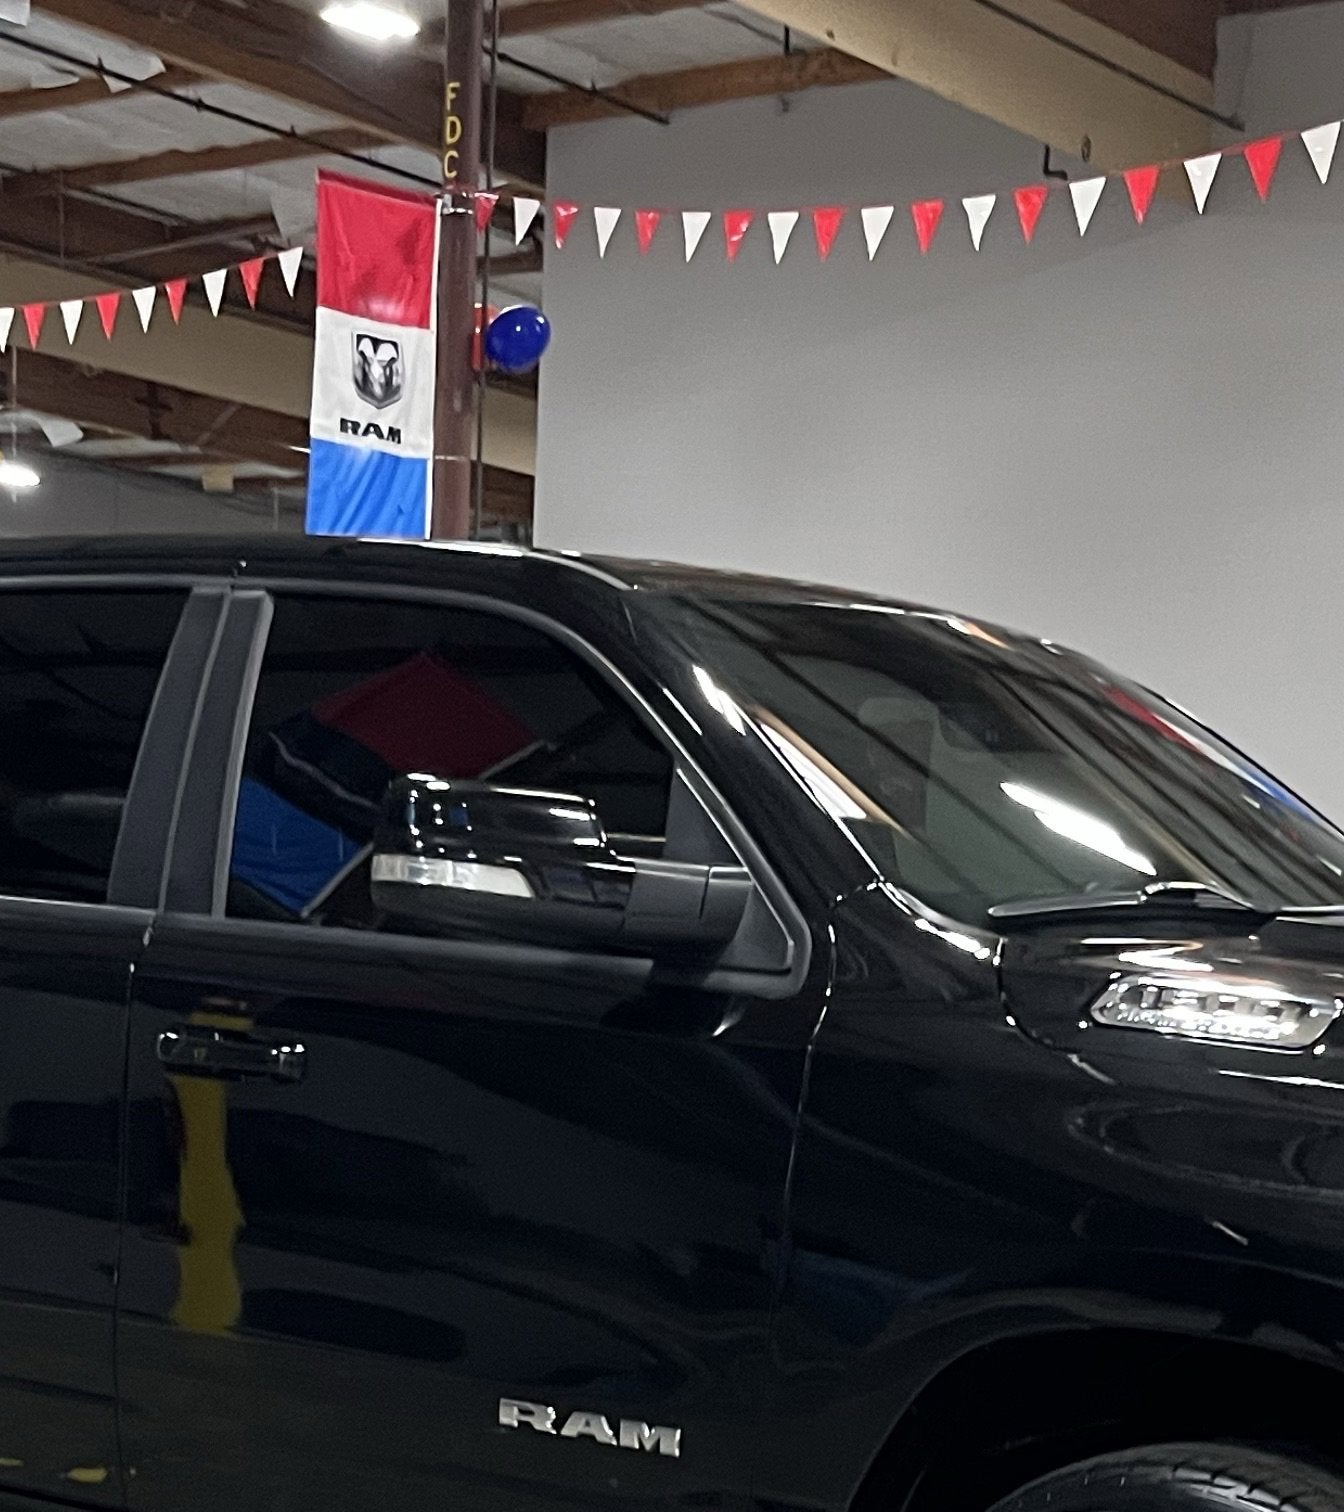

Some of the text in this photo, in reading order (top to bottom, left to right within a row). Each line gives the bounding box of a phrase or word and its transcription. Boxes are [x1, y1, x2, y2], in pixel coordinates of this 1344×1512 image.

[444, 82, 462, 178] FDC
[339, 417, 401, 444] RAM
[499, 1397, 681, 1457] RAM
